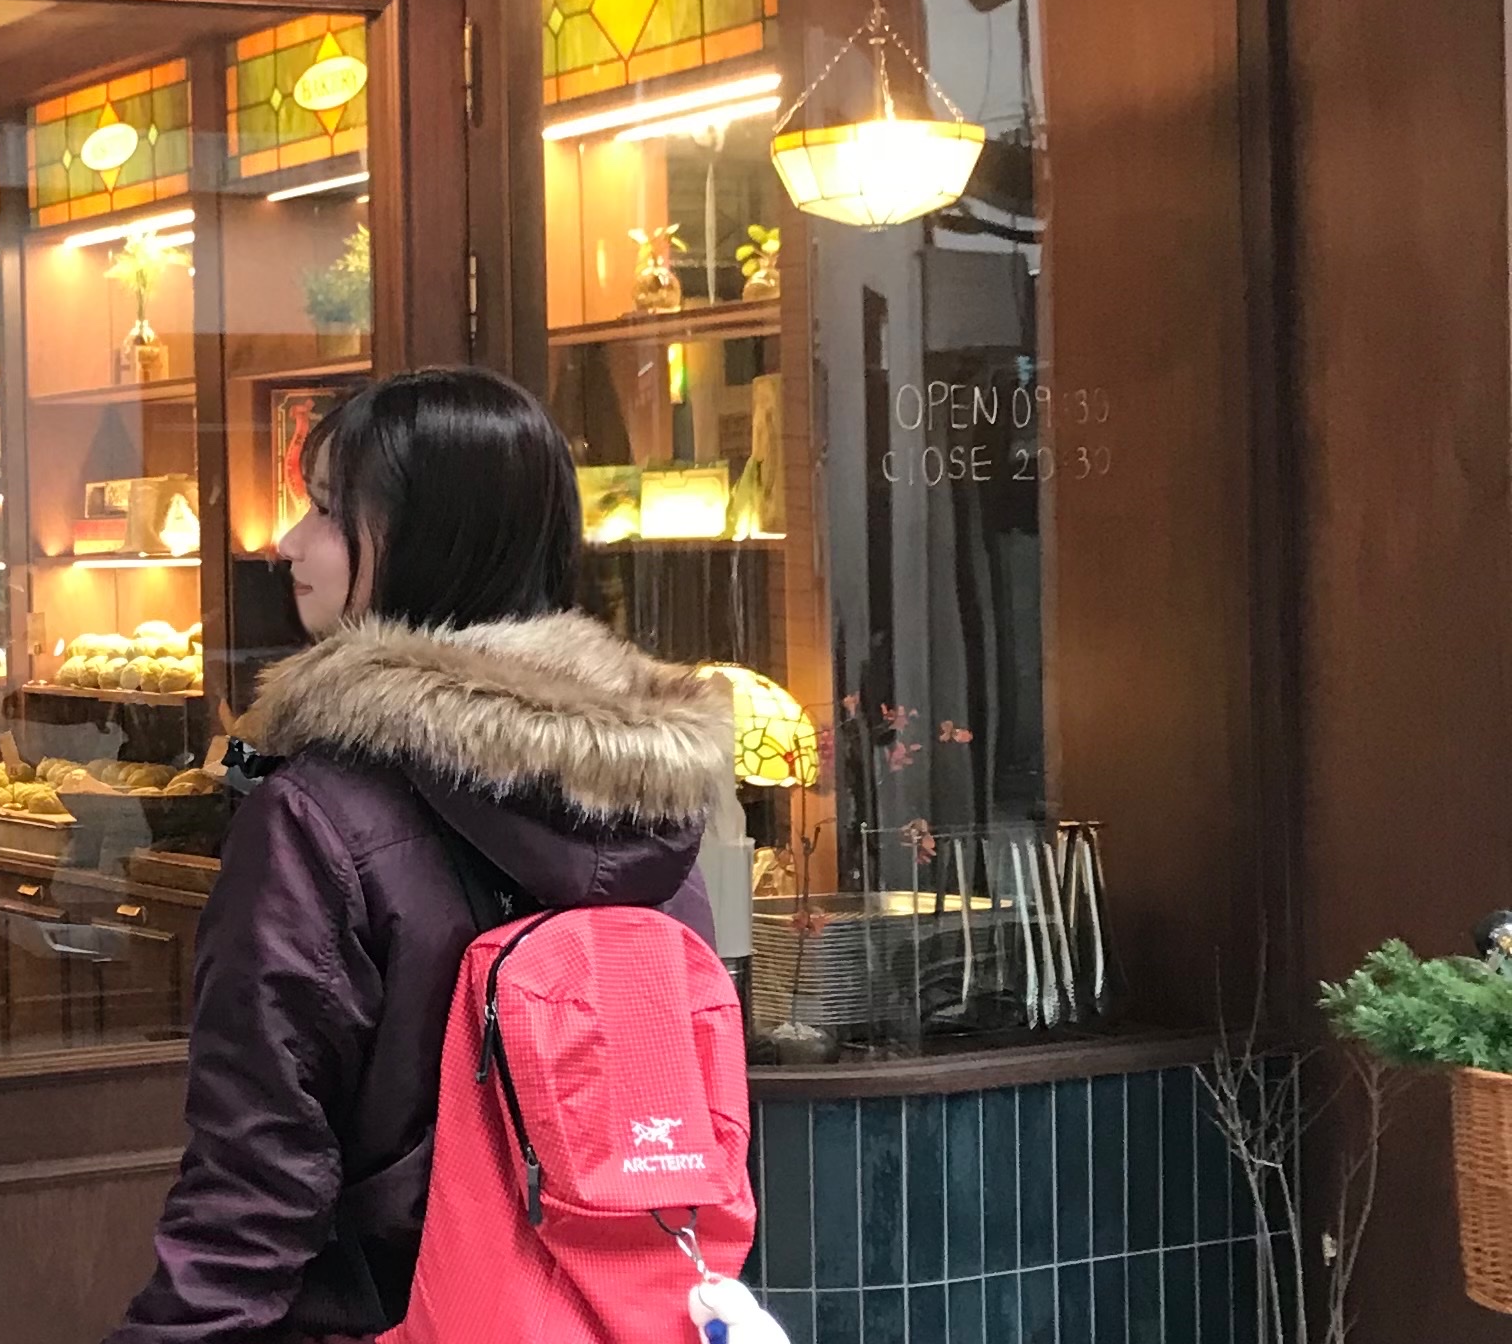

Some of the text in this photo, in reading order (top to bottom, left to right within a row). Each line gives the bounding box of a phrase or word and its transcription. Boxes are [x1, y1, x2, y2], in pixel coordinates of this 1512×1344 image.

[895, 380, 1110, 431] OPEN 09:30
[1012, 445, 1111, 481] 20:30
